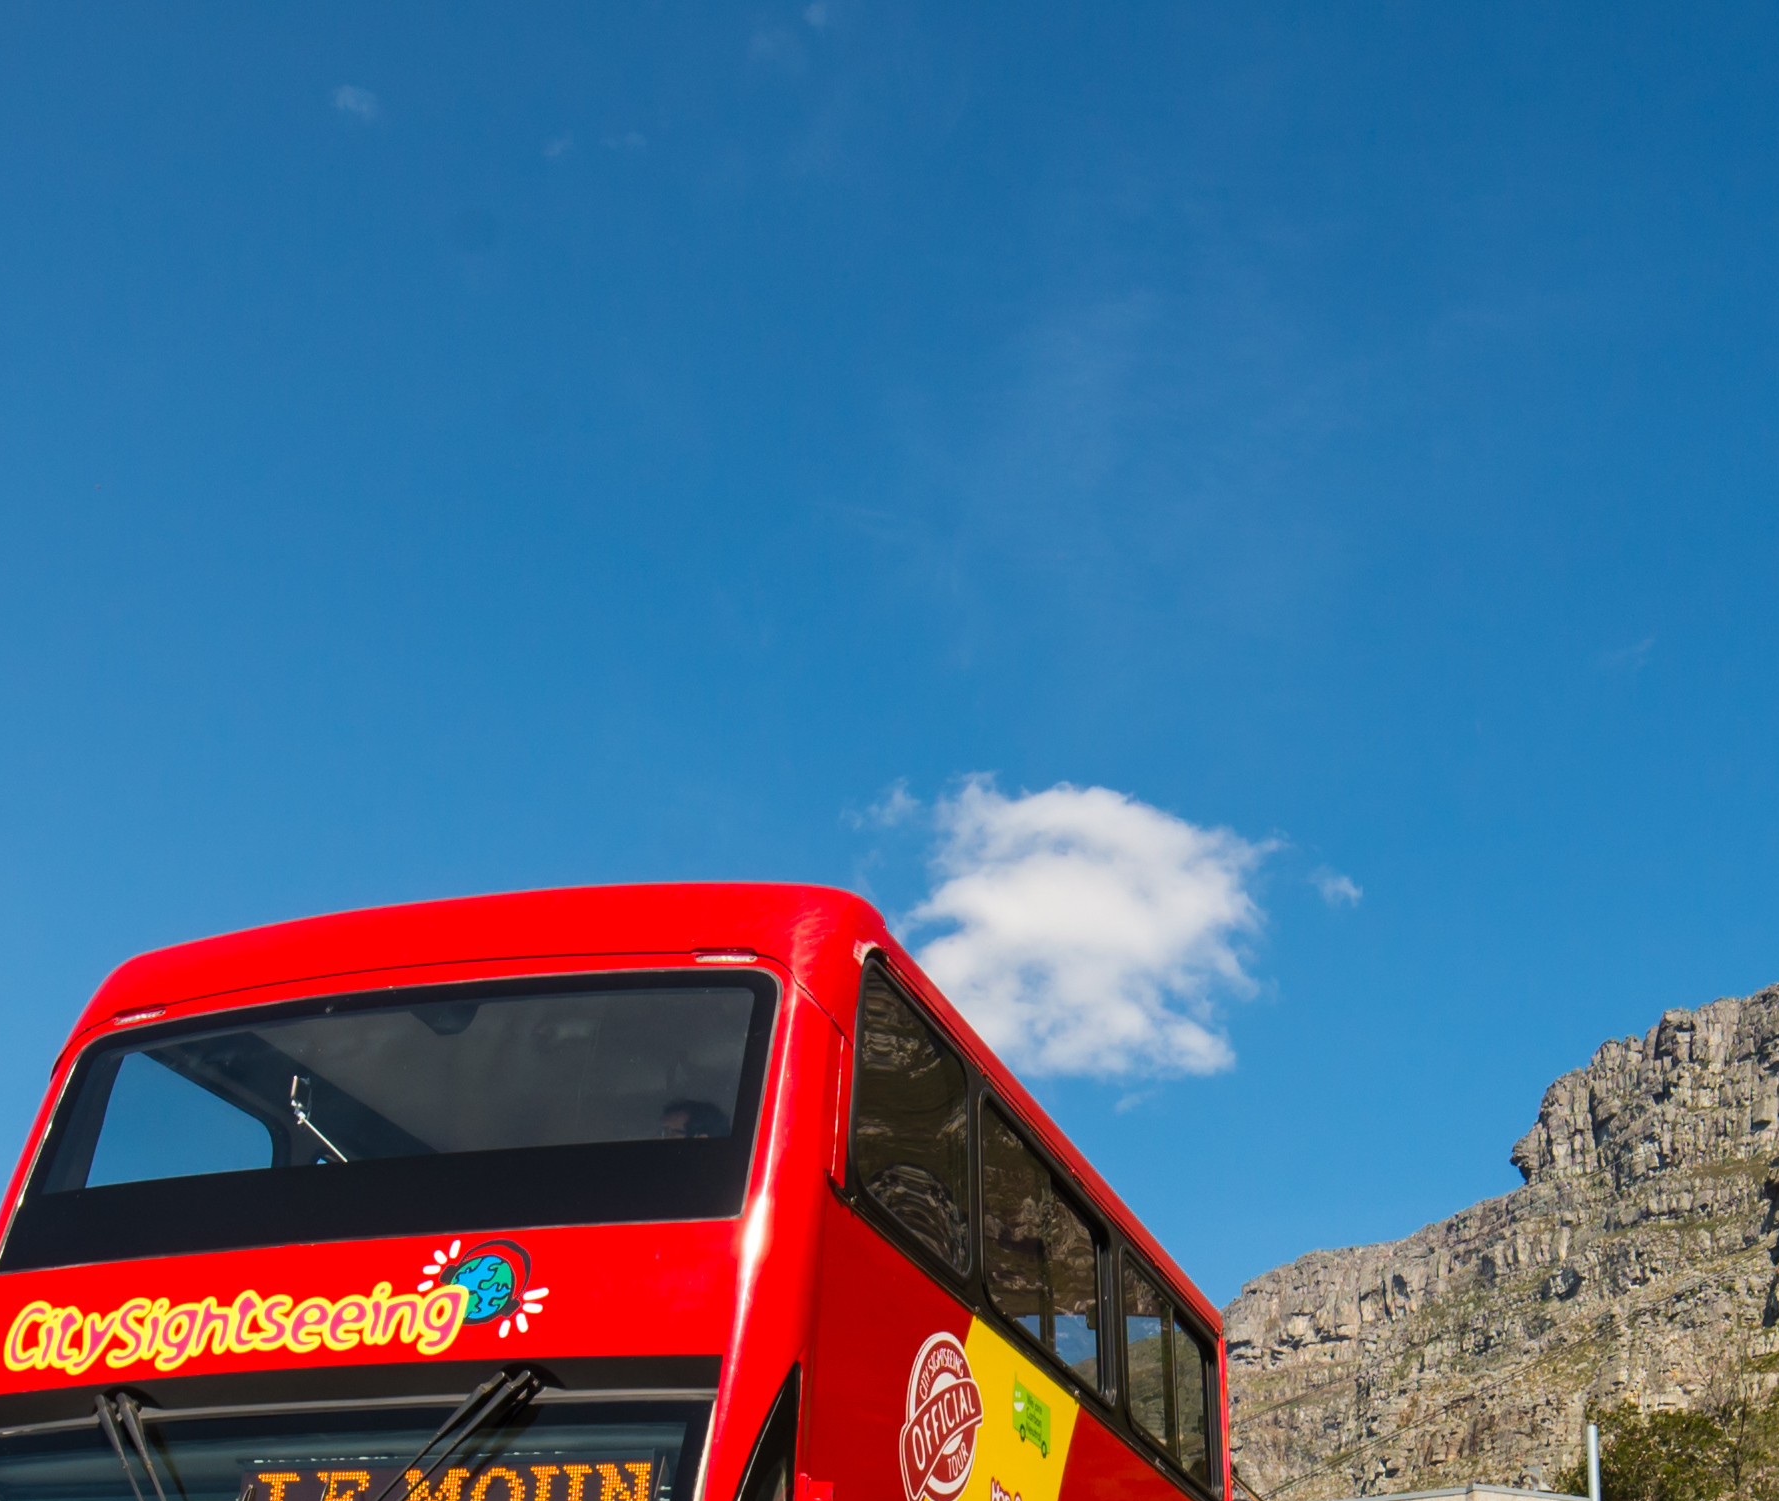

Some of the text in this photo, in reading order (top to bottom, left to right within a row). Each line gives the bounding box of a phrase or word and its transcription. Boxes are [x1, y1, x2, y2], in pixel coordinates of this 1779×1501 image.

[4, 1281, 471, 1375] CitySightseeing
[919, 1347, 964, 1400] CITY SIGHTSEEING
[912, 1385, 976, 1471] OFFICIAL
[947, 1441, 969, 1480] TOUR
